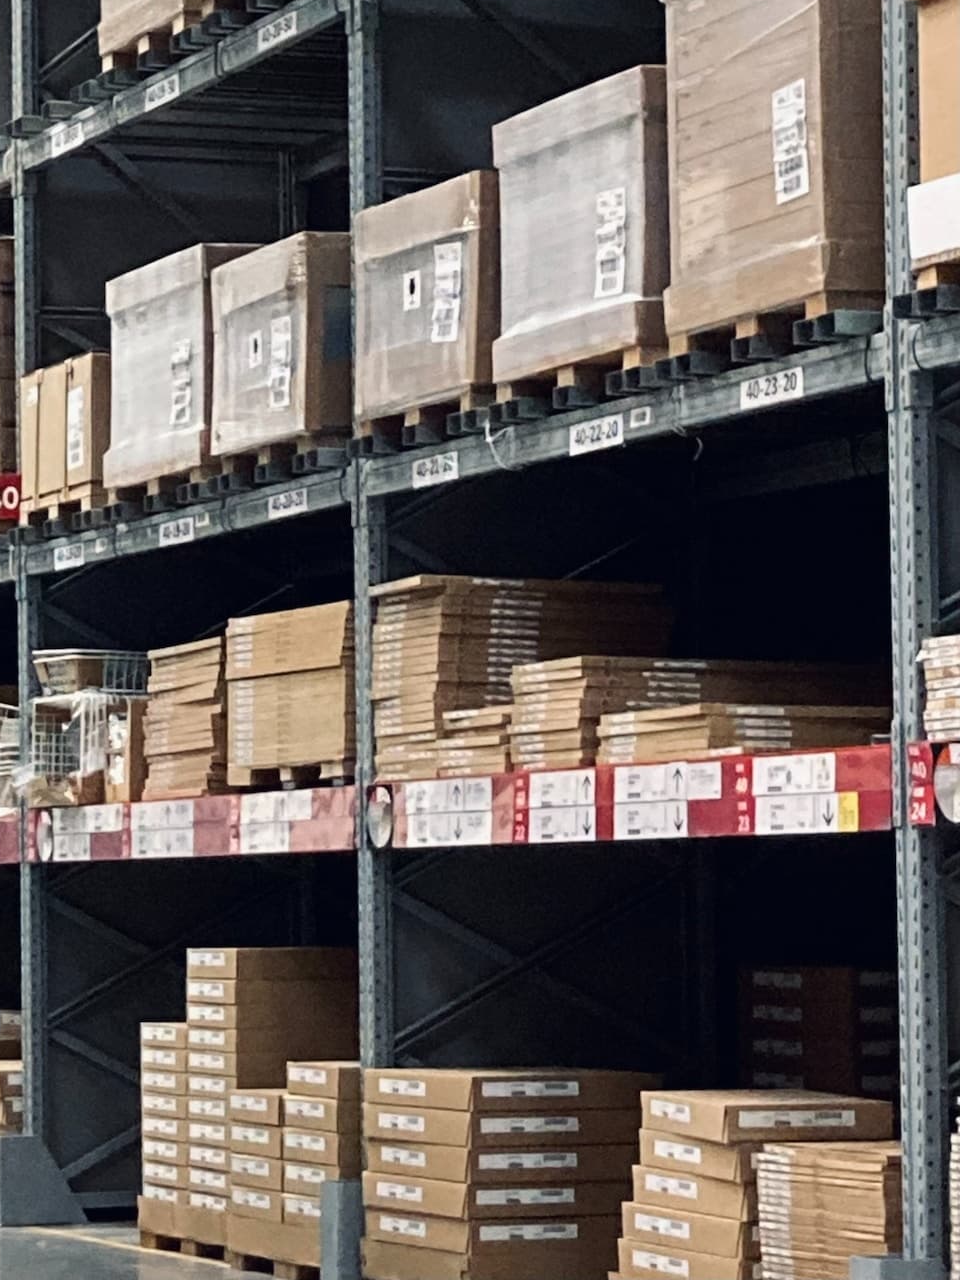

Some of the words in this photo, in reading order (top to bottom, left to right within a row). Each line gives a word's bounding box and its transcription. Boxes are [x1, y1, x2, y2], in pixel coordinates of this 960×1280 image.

[746, 372, 798, 401] 40-23-20
[574, 420, 619, 446] 40-22-20
[911, 802, 927, 821] 24
